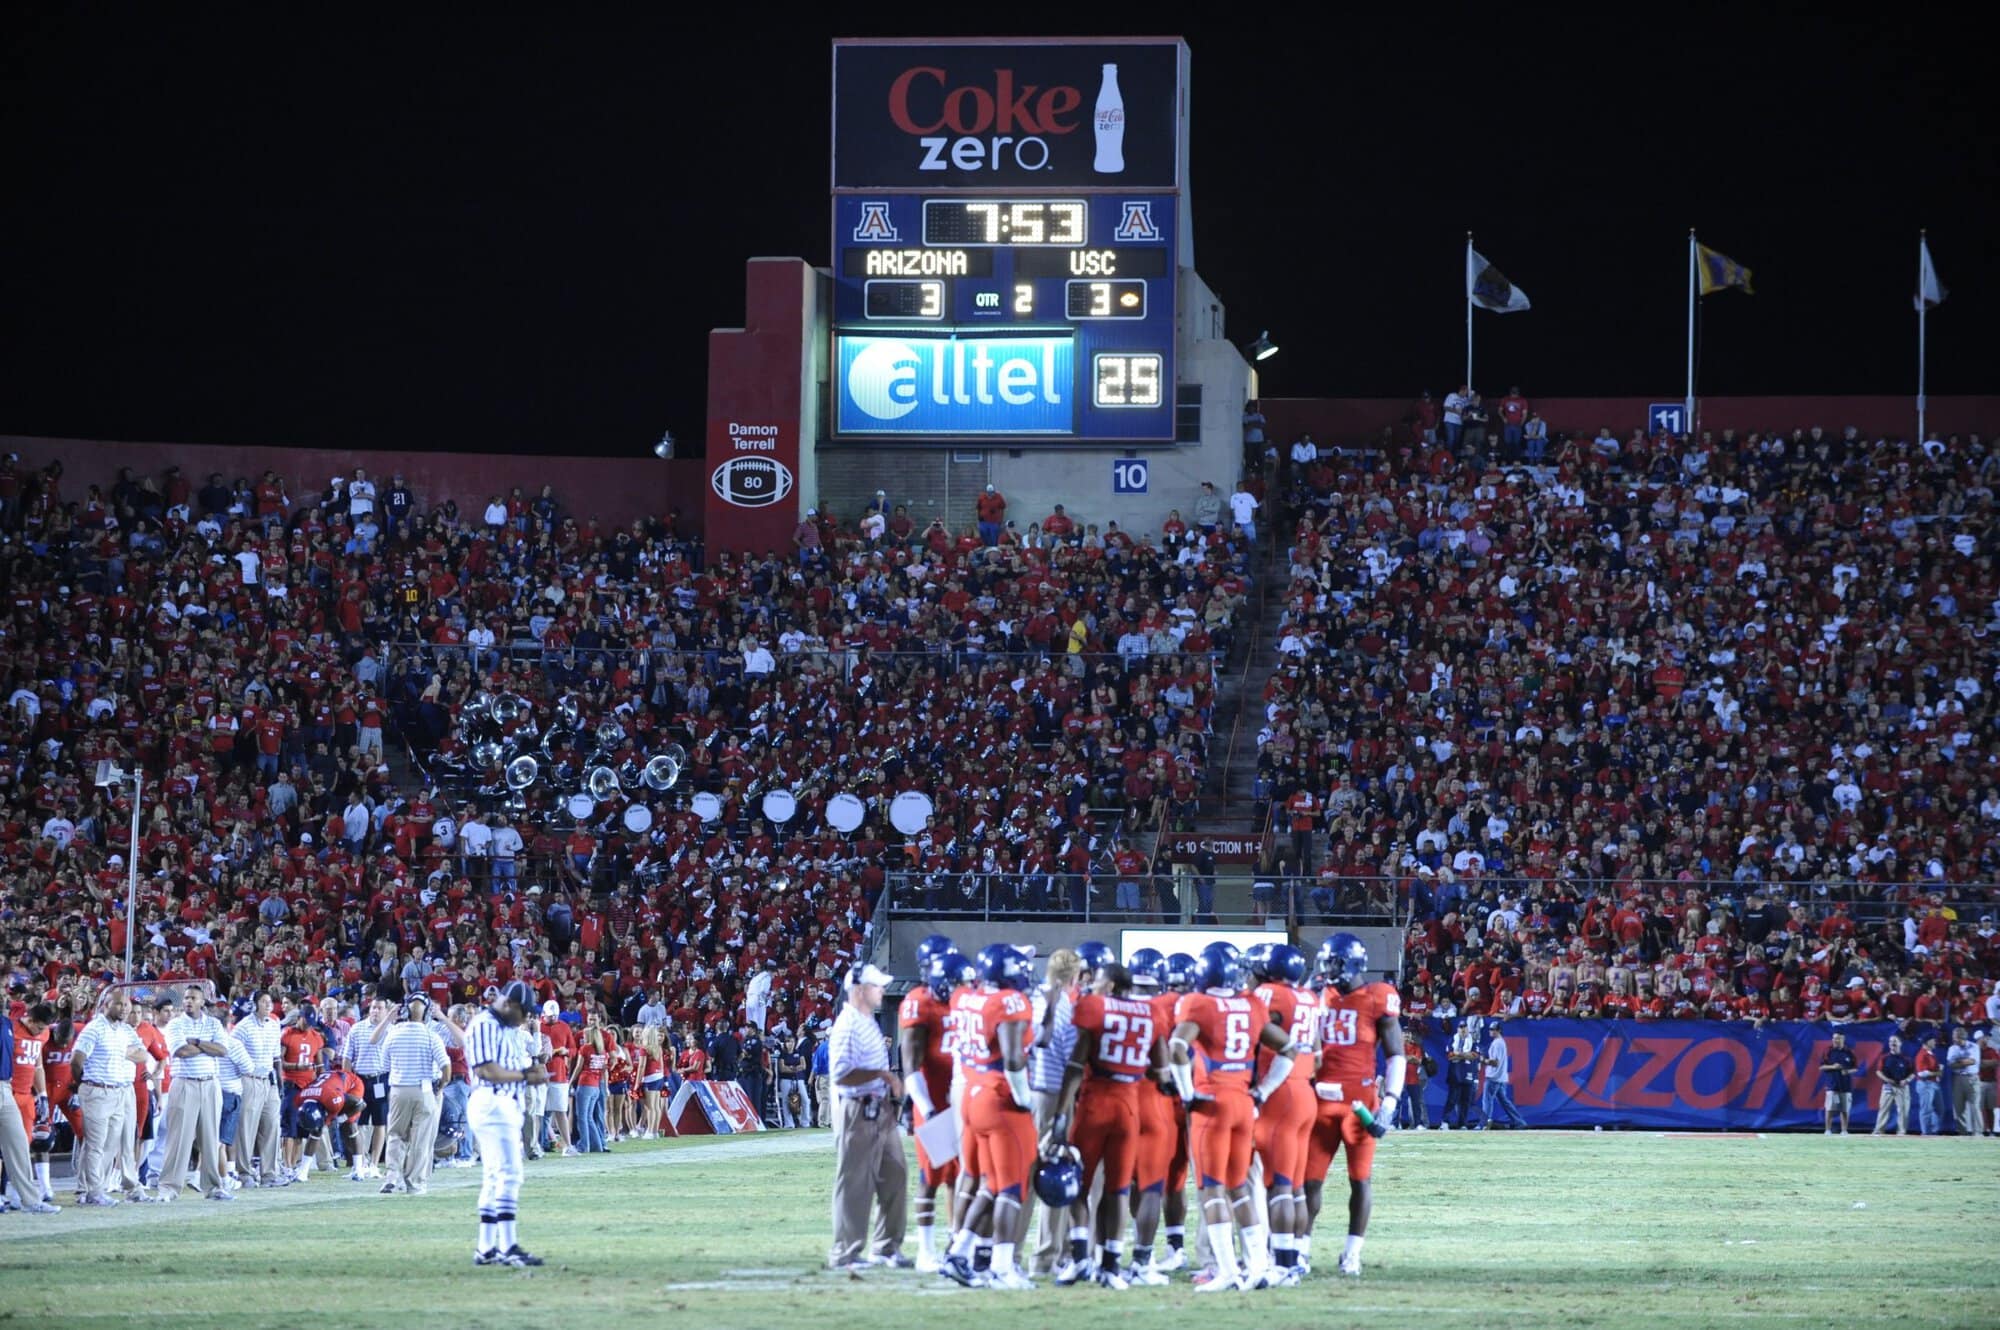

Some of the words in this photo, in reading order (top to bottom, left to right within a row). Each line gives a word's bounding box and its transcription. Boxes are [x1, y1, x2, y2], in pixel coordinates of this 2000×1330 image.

[888, 66, 1081, 136] Coke
[966, 203, 1083, 242] 7:53
[866, 250, 967, 275] ARIZONA
[1070, 250, 1116, 275] USC
[920, 283, 941, 315] 3
[975, 292, 1000, 307] QTR
[1014, 284, 1033, 313] 2
[1090, 283, 1110, 315] 3
[888, 339, 1061, 405] alltel
[1098, 357, 1158, 404] 25
[728, 422, 778, 436] Damon
[1655, 409, 1680, 434] 11
[732, 437, 775, 450] Terrell
[743, 476, 763, 489] 80
[1114, 463, 1147, 489] 10
[393, 492, 406, 506] 21
[405, 589, 418, 603] 10
[440, 825, 448, 836] 3
[1185, 841, 1197, 854] 10
[1200, 841, 1241, 854] SCTION
[1244, 841, 1253, 854] 11
[1099, 1012, 1153, 1067] 23
[1224, 1013, 1251, 1060] 6
[299, 1043, 311, 1065] 2
